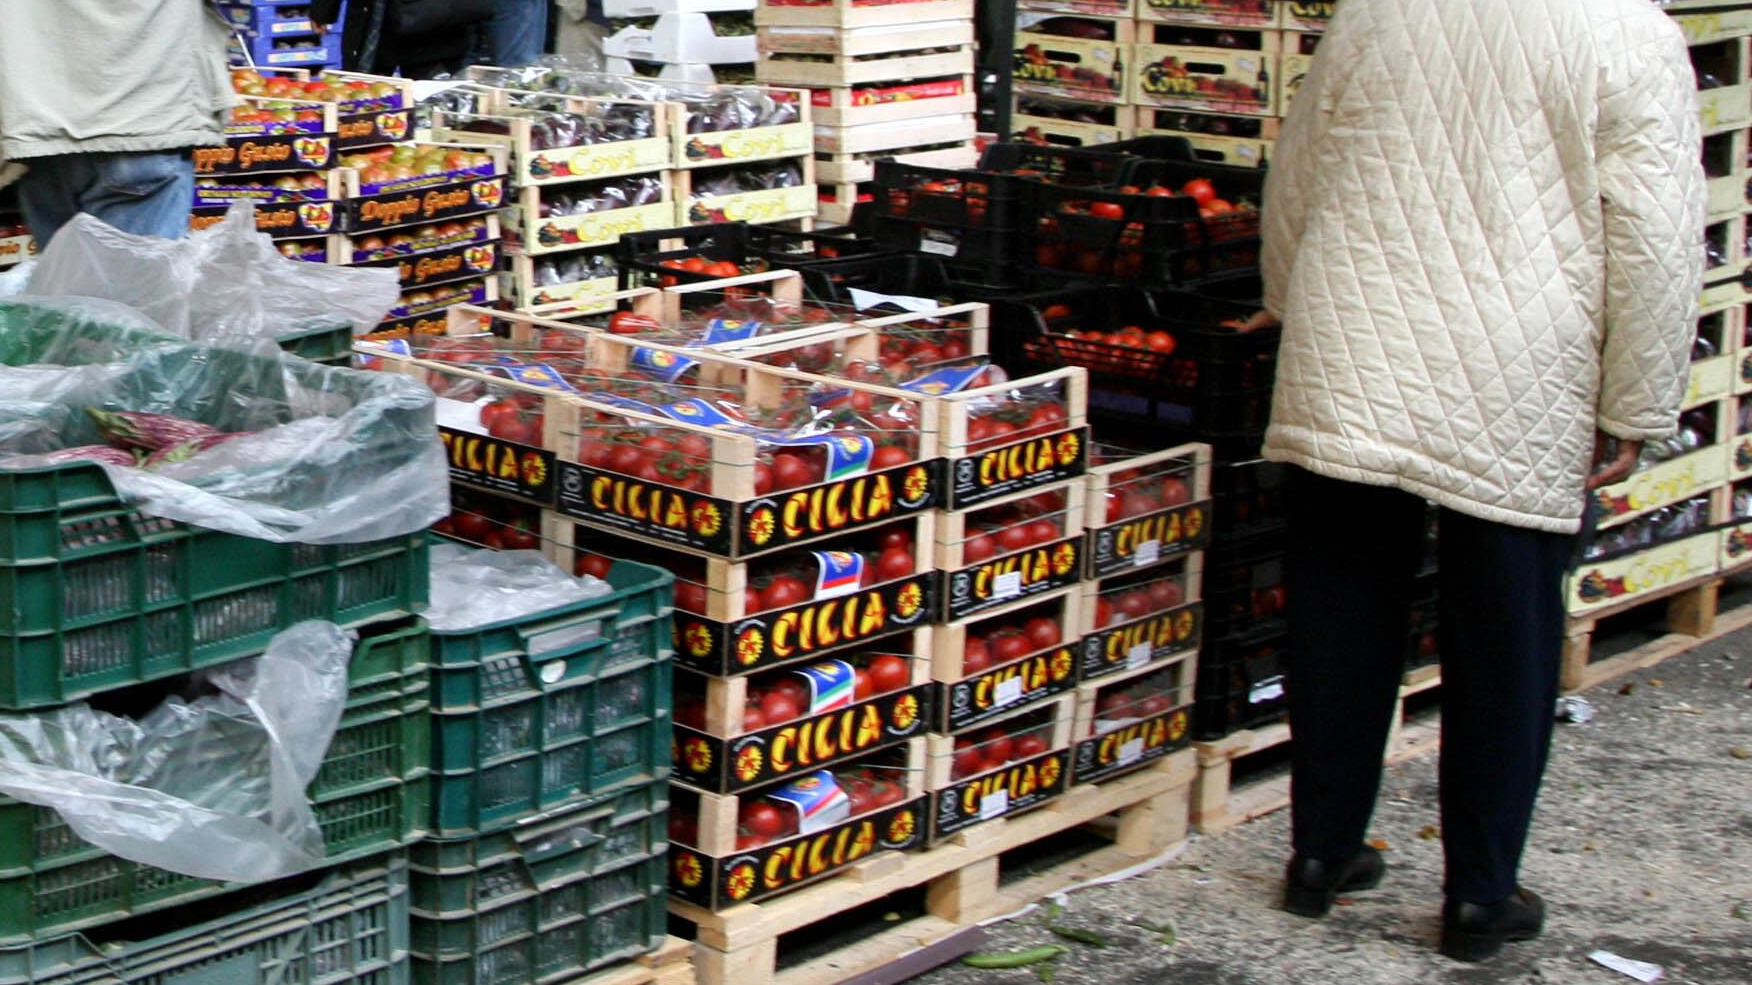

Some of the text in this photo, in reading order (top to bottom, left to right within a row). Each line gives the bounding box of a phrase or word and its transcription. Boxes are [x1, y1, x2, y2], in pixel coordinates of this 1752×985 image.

[238, 141, 292, 169] Gusto
[721, 132, 785, 159] Covi
[568, 147, 636, 176] Covi
[360, 188, 471, 225] Doppio Gusto
[723, 195, 787, 222] Covi
[576, 214, 643, 242] Covi
[414, 254, 463, 284] Gusto
[1627, 462, 1695, 509] Covi
[1622, 551, 1691, 593] Covi
